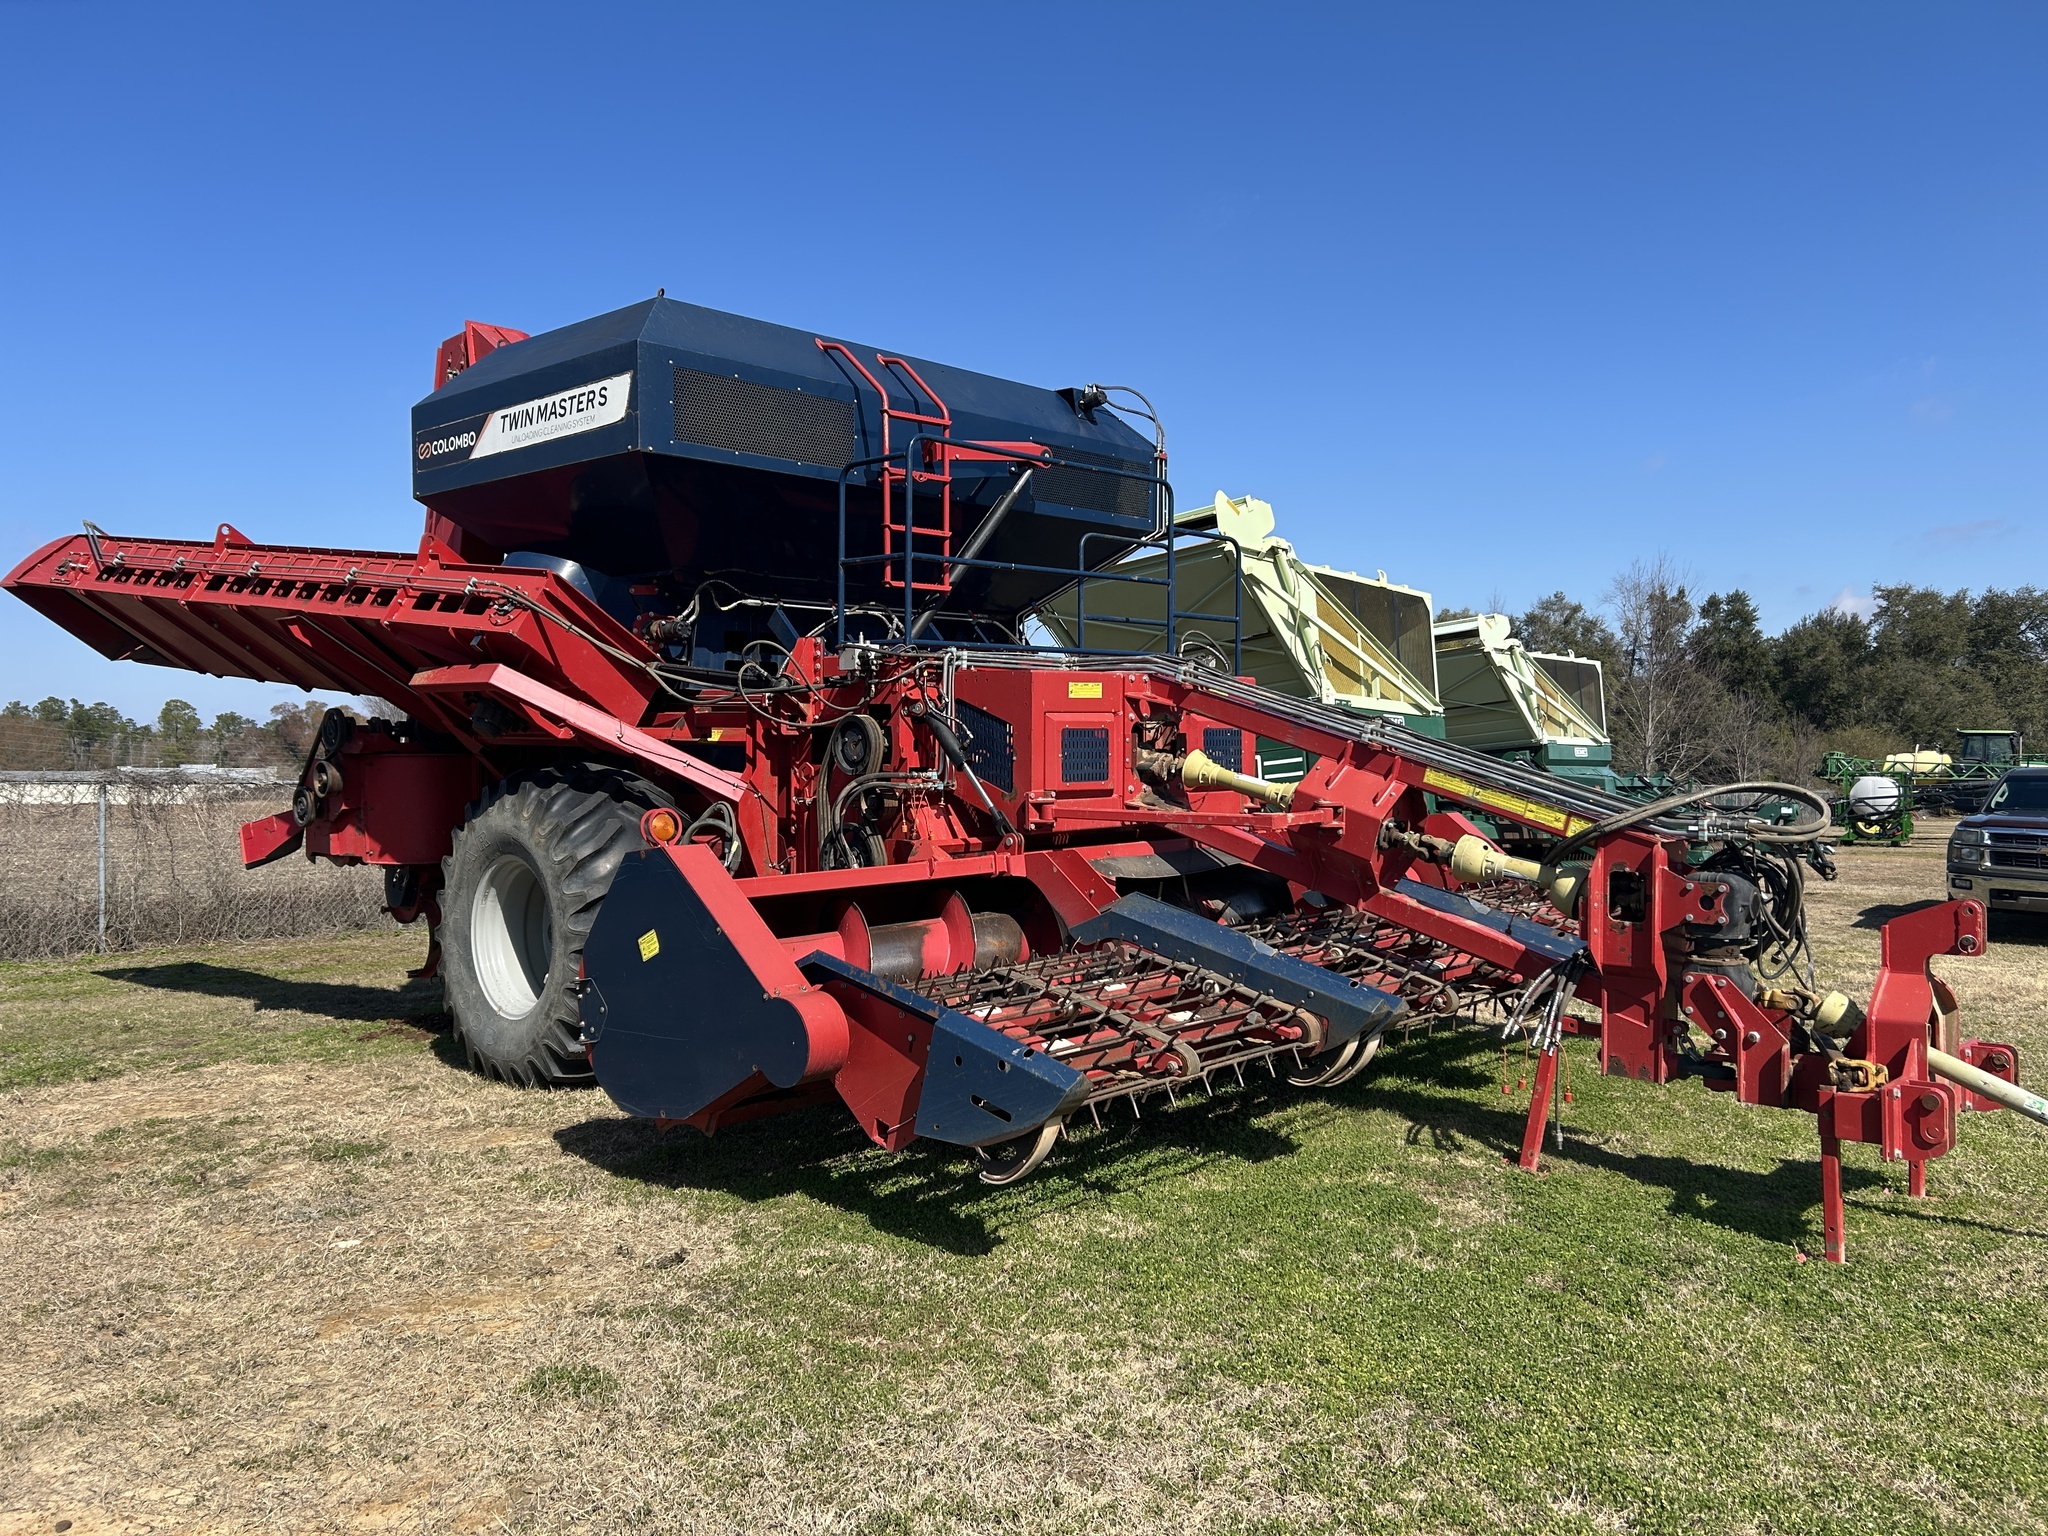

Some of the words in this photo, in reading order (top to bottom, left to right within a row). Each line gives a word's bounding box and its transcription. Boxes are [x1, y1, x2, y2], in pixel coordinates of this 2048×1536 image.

[500, 407, 534, 433] TWIN
[536, 389, 595, 425] MASTER
[598, 386, 608, 406] S
[431, 431, 476, 455] COLOMBO
[511, 428, 543, 444] UNLOADING
[543, 420, 572, 436] CLEANING
[573, 414, 596, 429] SYSTEM
